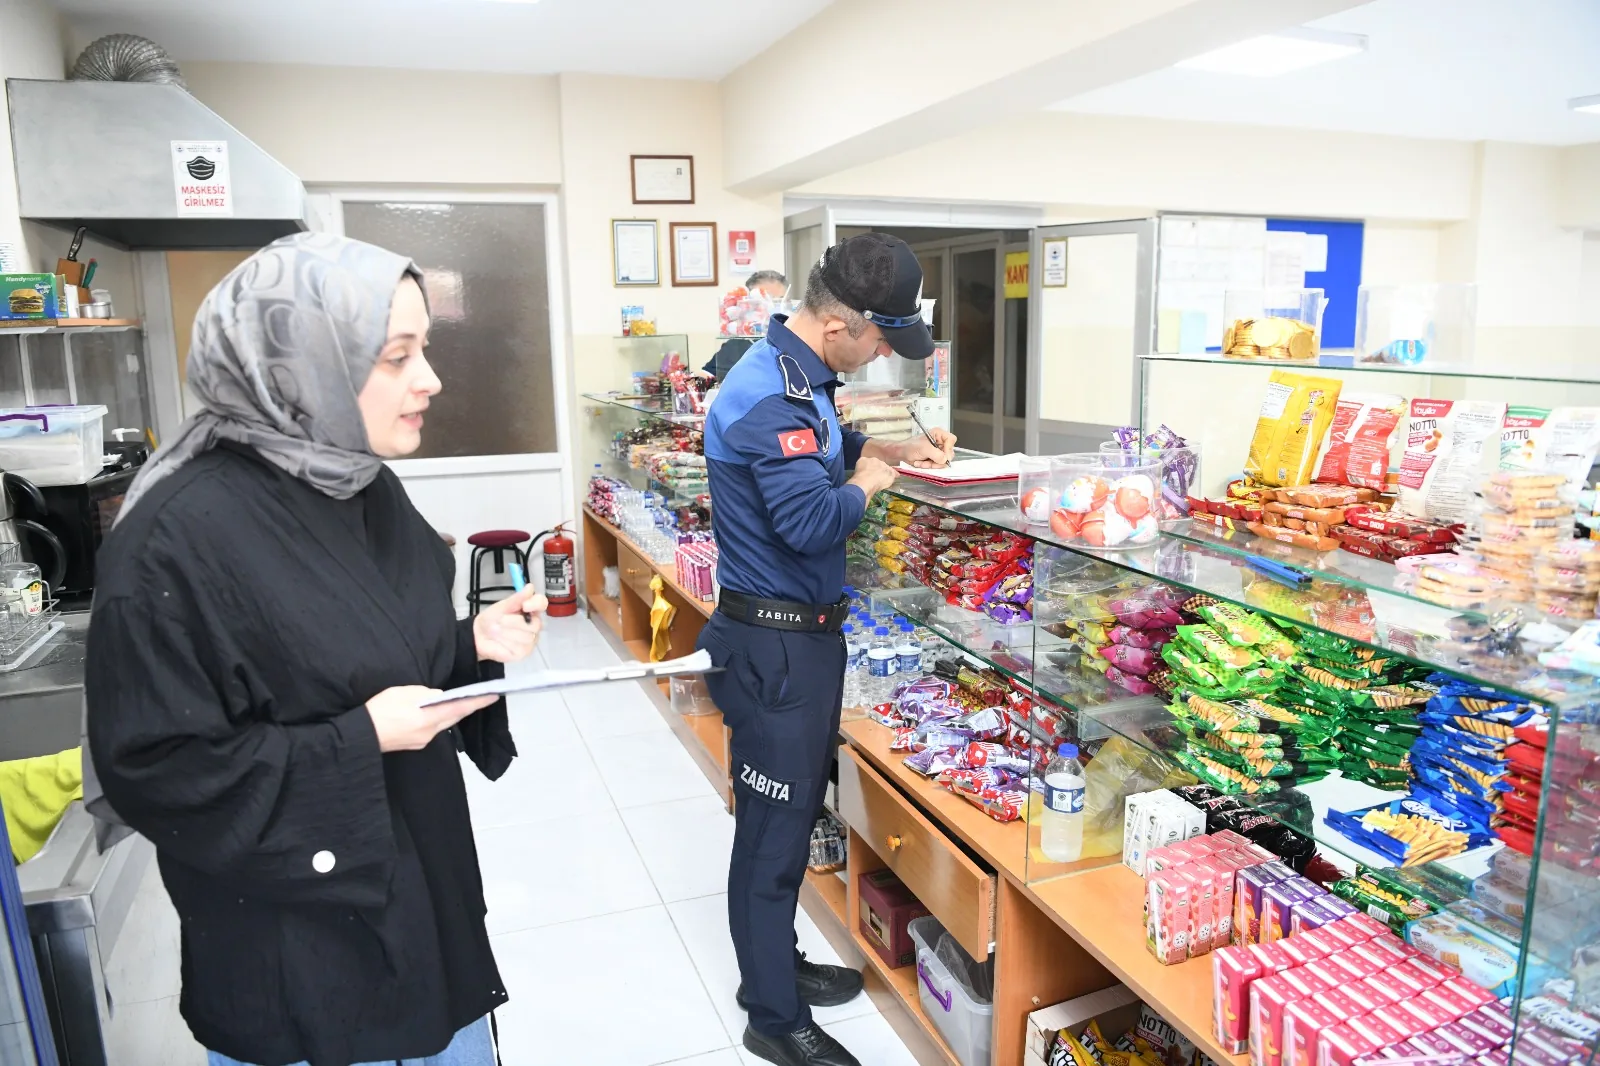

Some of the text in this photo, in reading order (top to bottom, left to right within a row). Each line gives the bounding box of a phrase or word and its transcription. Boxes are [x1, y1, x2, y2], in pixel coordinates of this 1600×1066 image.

[181, 183, 225, 195] MASKESİZ
[184, 195, 225, 207] GİRİLMEZ
[1409, 419, 1437, 433] NOTTO
[757, 609, 802, 623] ZABITA
[740, 763, 790, 802] ZABITA
[1138, 1012, 1177, 1044] NOTTO
